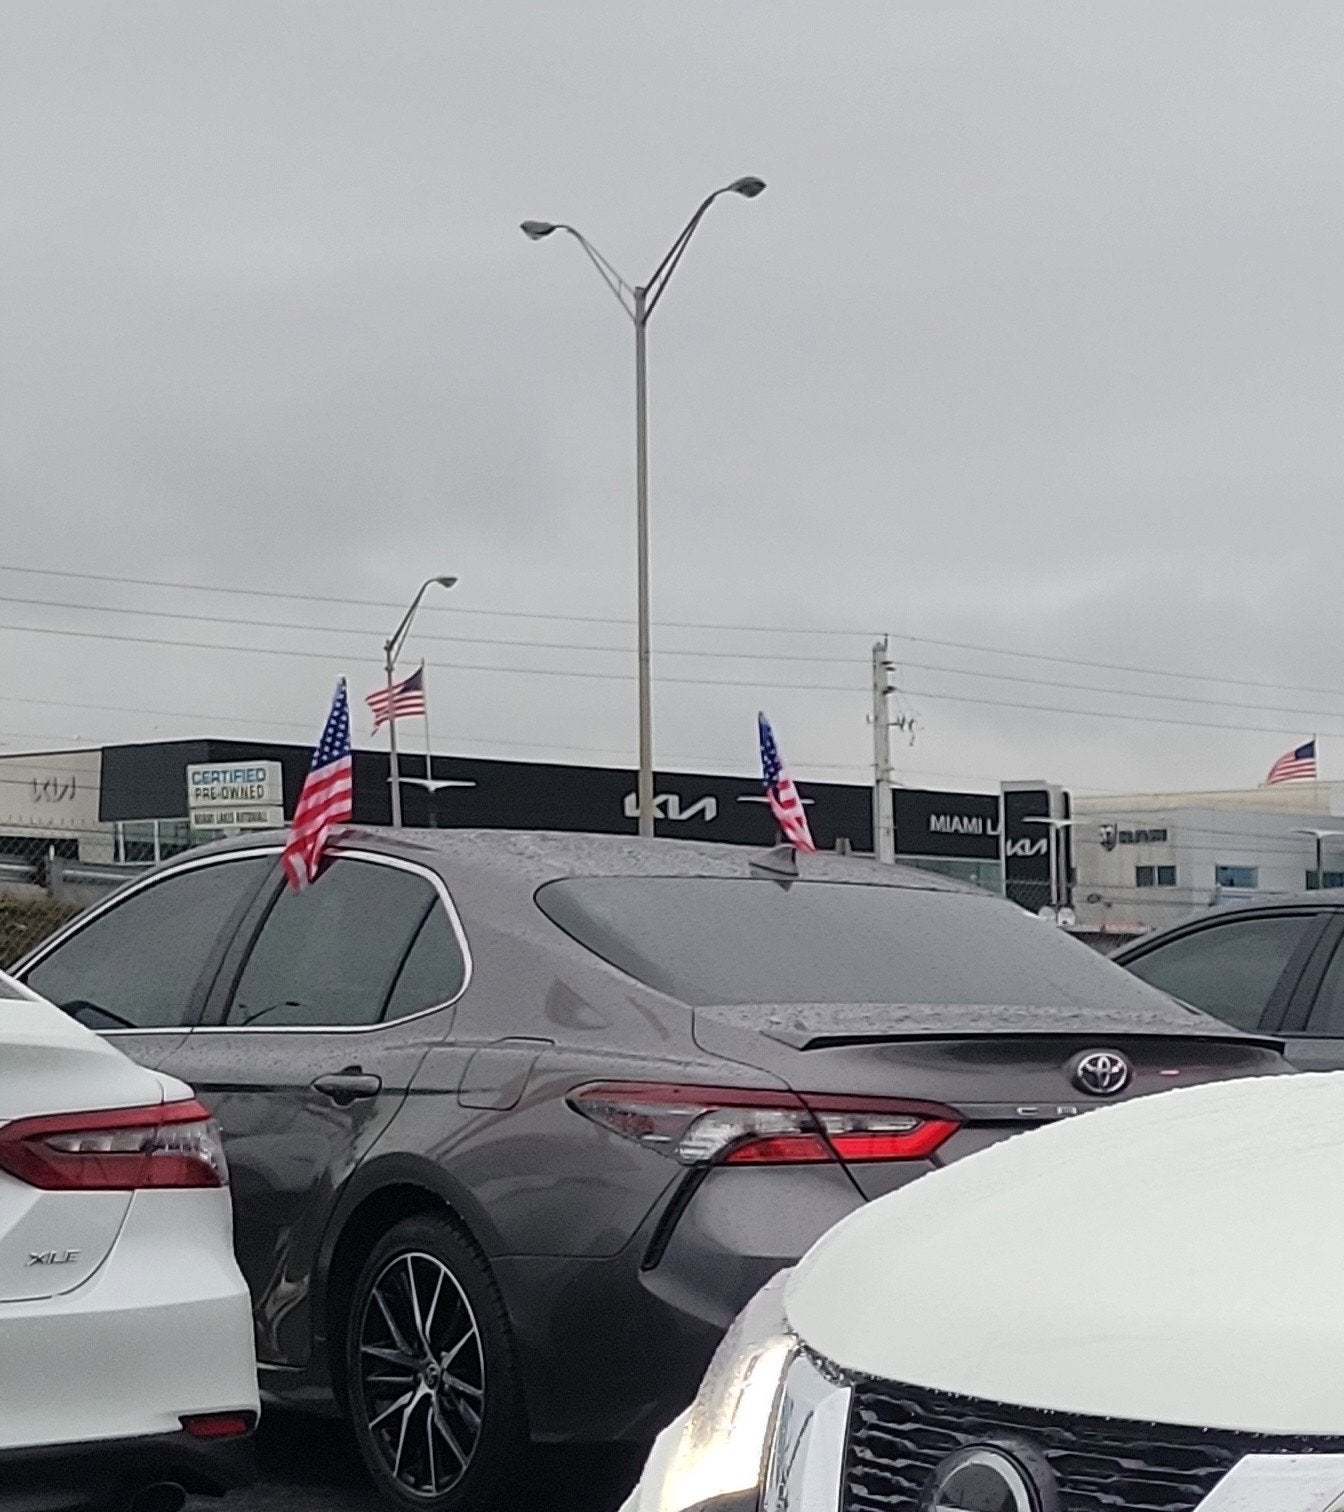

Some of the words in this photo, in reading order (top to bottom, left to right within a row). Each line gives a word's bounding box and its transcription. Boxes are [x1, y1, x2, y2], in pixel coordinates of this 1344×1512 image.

[191, 767, 267, 786] CERTIFIED
[195, 784, 265, 801] PRE-OWNED
[929, 814, 983, 835] MIAMI
[1118, 828, 1168, 845] RAM
[25, 1249, 81, 1267] XLE
